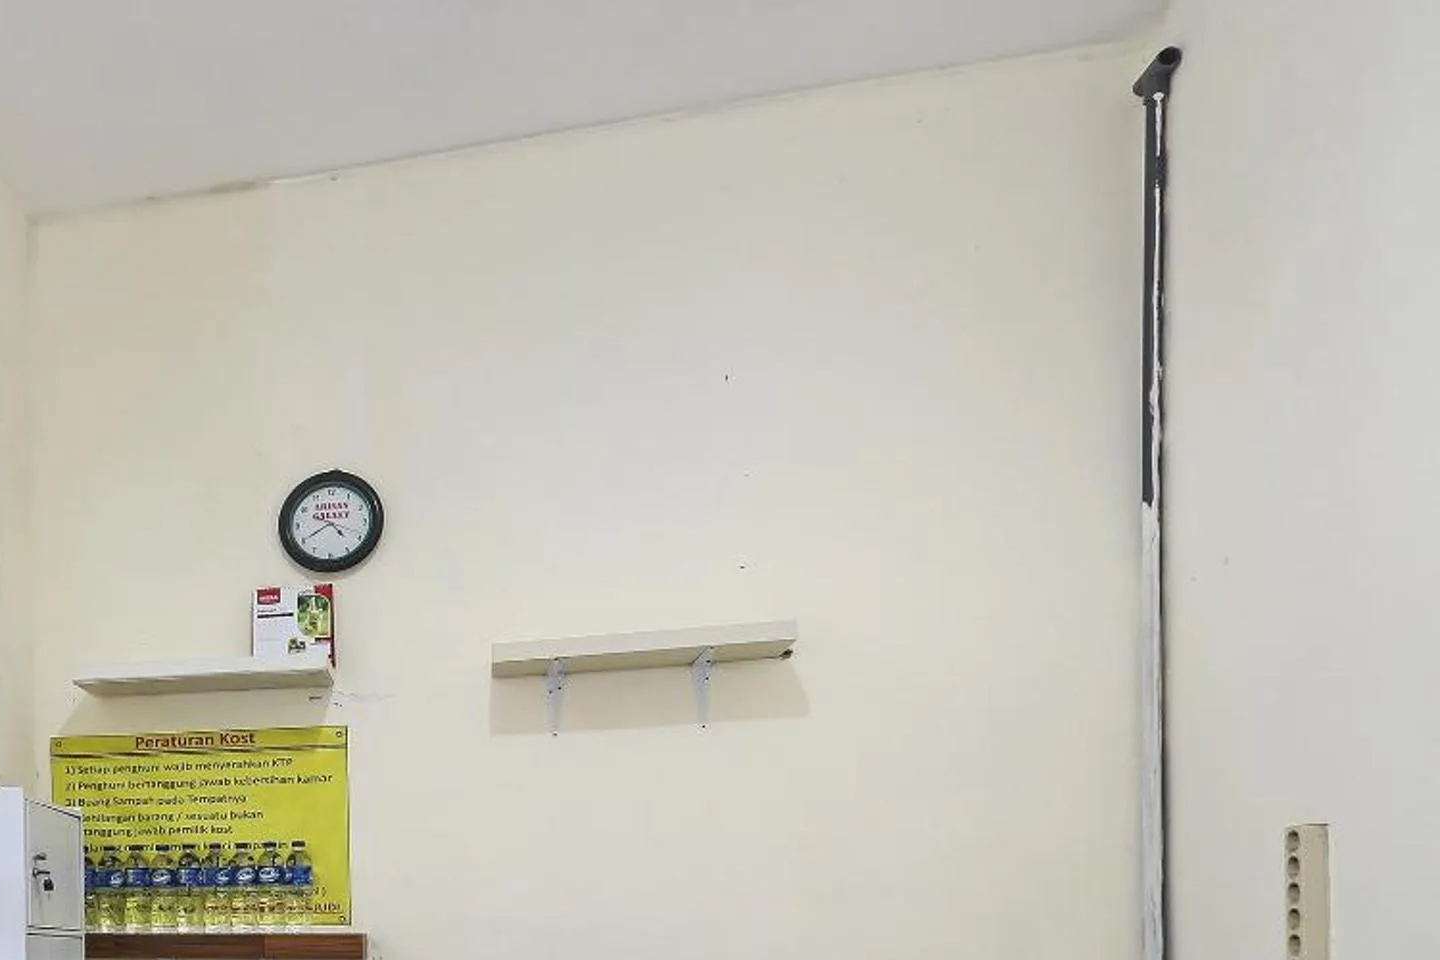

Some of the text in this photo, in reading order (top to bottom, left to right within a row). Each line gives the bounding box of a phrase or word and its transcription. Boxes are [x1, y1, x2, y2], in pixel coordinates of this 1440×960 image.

[136, 733, 255, 749] Peraturan Kost
[78, 766, 109, 776] Setiap
[113, 764, 159, 775] penghuni
[164, 762, 192, 773] wajib
[195, 760, 269, 771] menyerahkan
[272, 758, 293, 767] KTP
[78, 781, 125, 792] Penghuni
[128, 779, 196, 791] bertanggung
[234, 775, 294, 785] kebersihan
[297, 773, 332, 783] kamar
[188, 793, 247, 806] Tempatnya
[138, 812, 174, 824] barang
[230, 809, 264, 819] bukan
[84, 827, 134, 838] tanggung
[168, 824, 208, 836] pemilik
